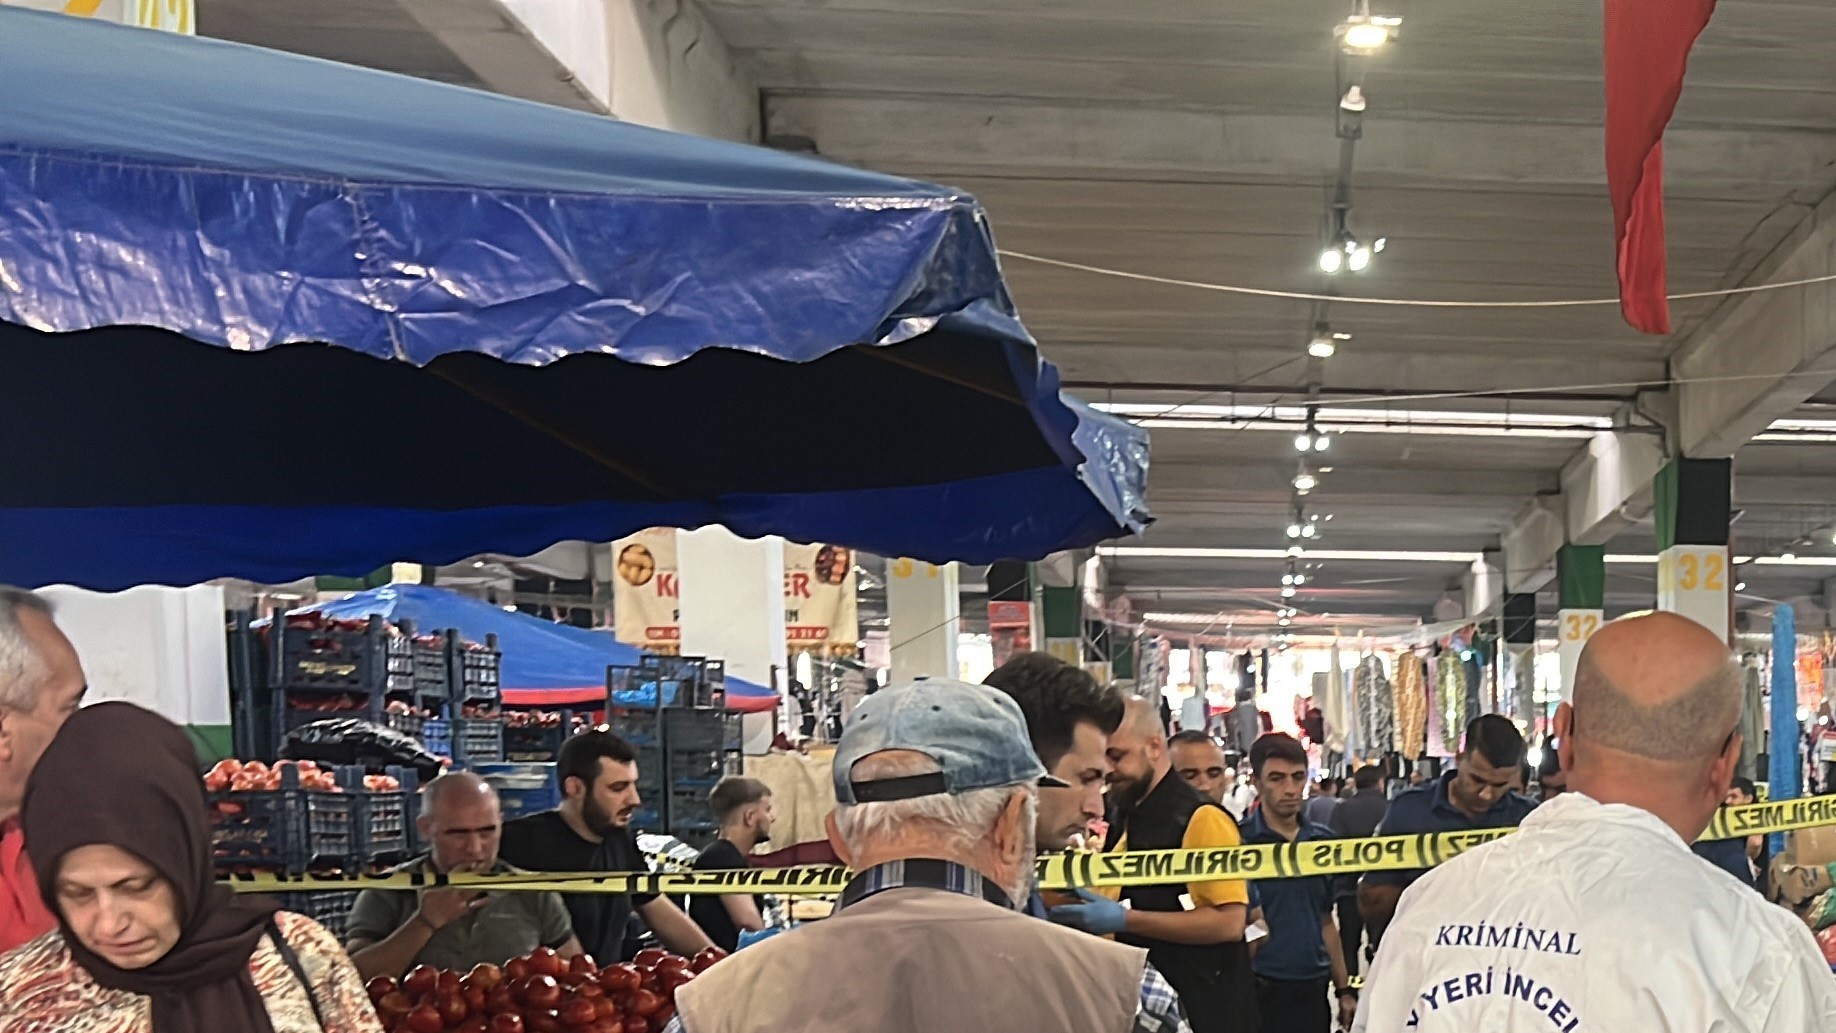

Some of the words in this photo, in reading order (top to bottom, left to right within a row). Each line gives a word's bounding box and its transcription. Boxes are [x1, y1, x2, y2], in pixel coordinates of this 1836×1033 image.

[1678, 553, 1723, 591] 32
[1435, 920, 1582, 956] KRİMİNAL
[1421, 965, 1494, 1010] YERİ
